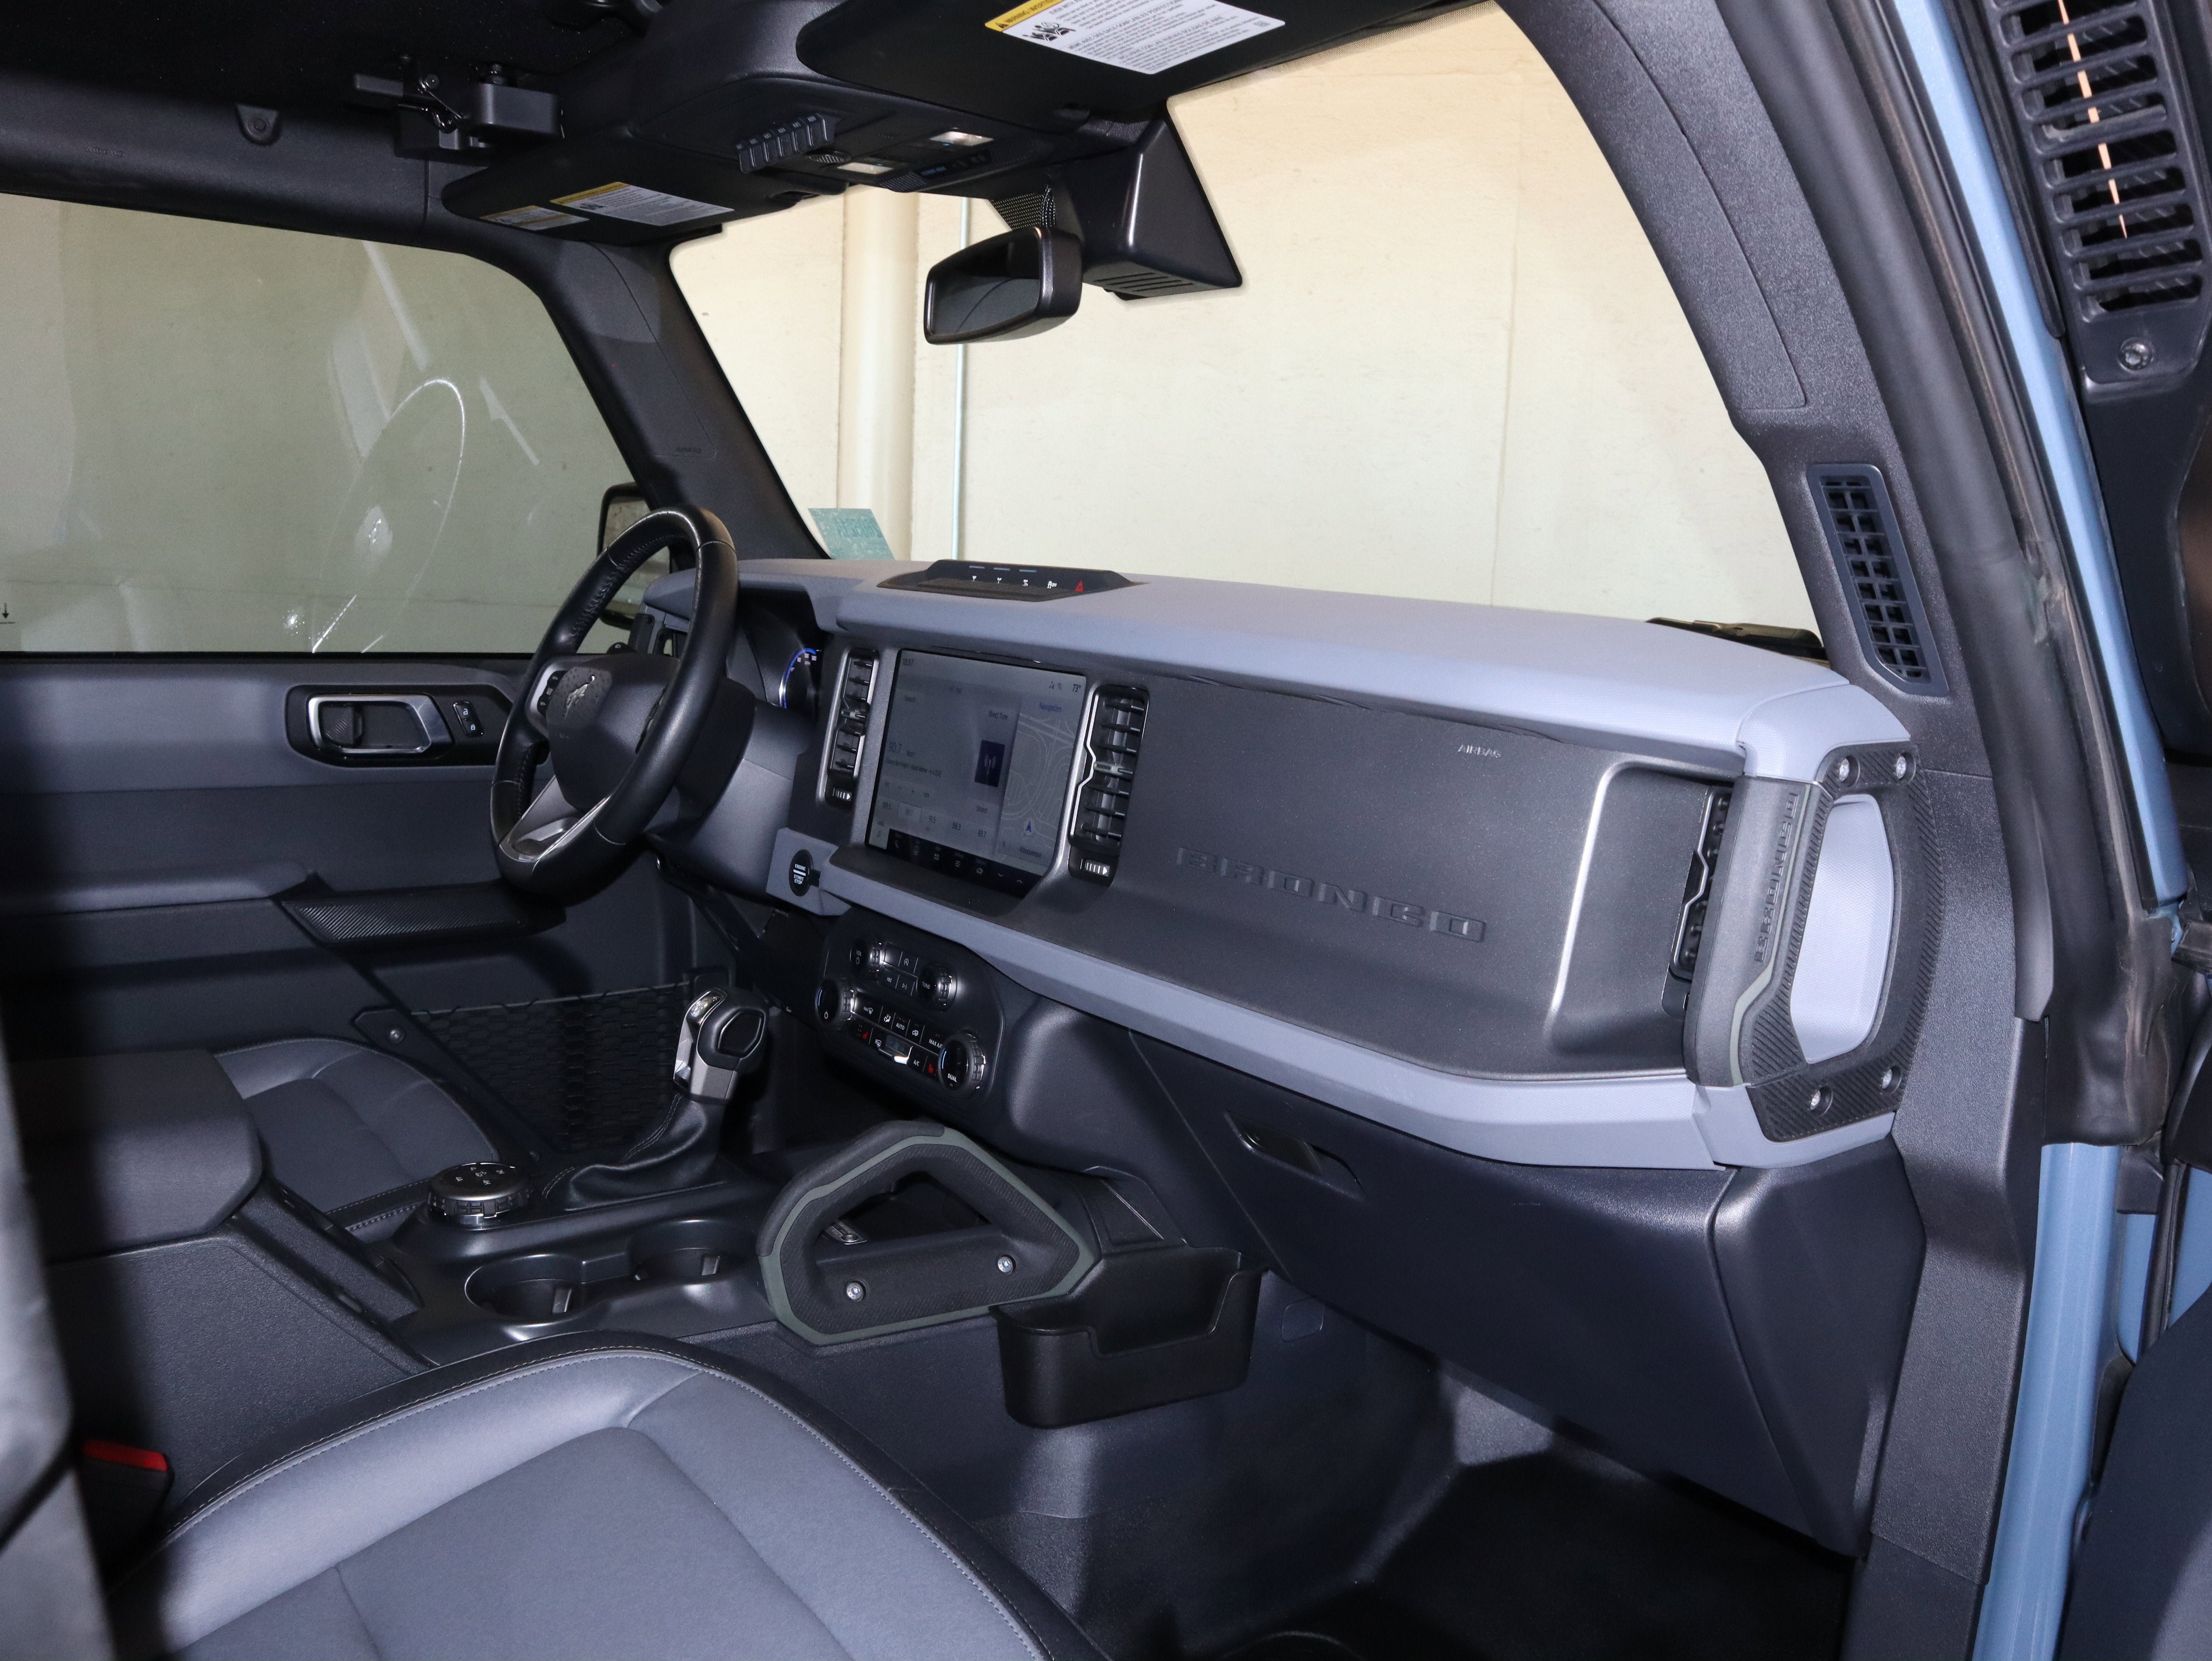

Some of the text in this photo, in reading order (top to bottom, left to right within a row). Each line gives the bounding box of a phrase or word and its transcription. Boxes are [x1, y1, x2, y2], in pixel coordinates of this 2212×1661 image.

[1457, 744, 1502, 759] AIRBAG
[1754, 792, 1799, 963] BRONCO
[1175, 847, 1487, 943] BRONCO
[922, 981, 931, 990] TUNE
[896, 1022, 905, 1031] AUTO
[928, 1039, 937, 1047] MAX
[947, 1073, 957, 1083] DUAL
